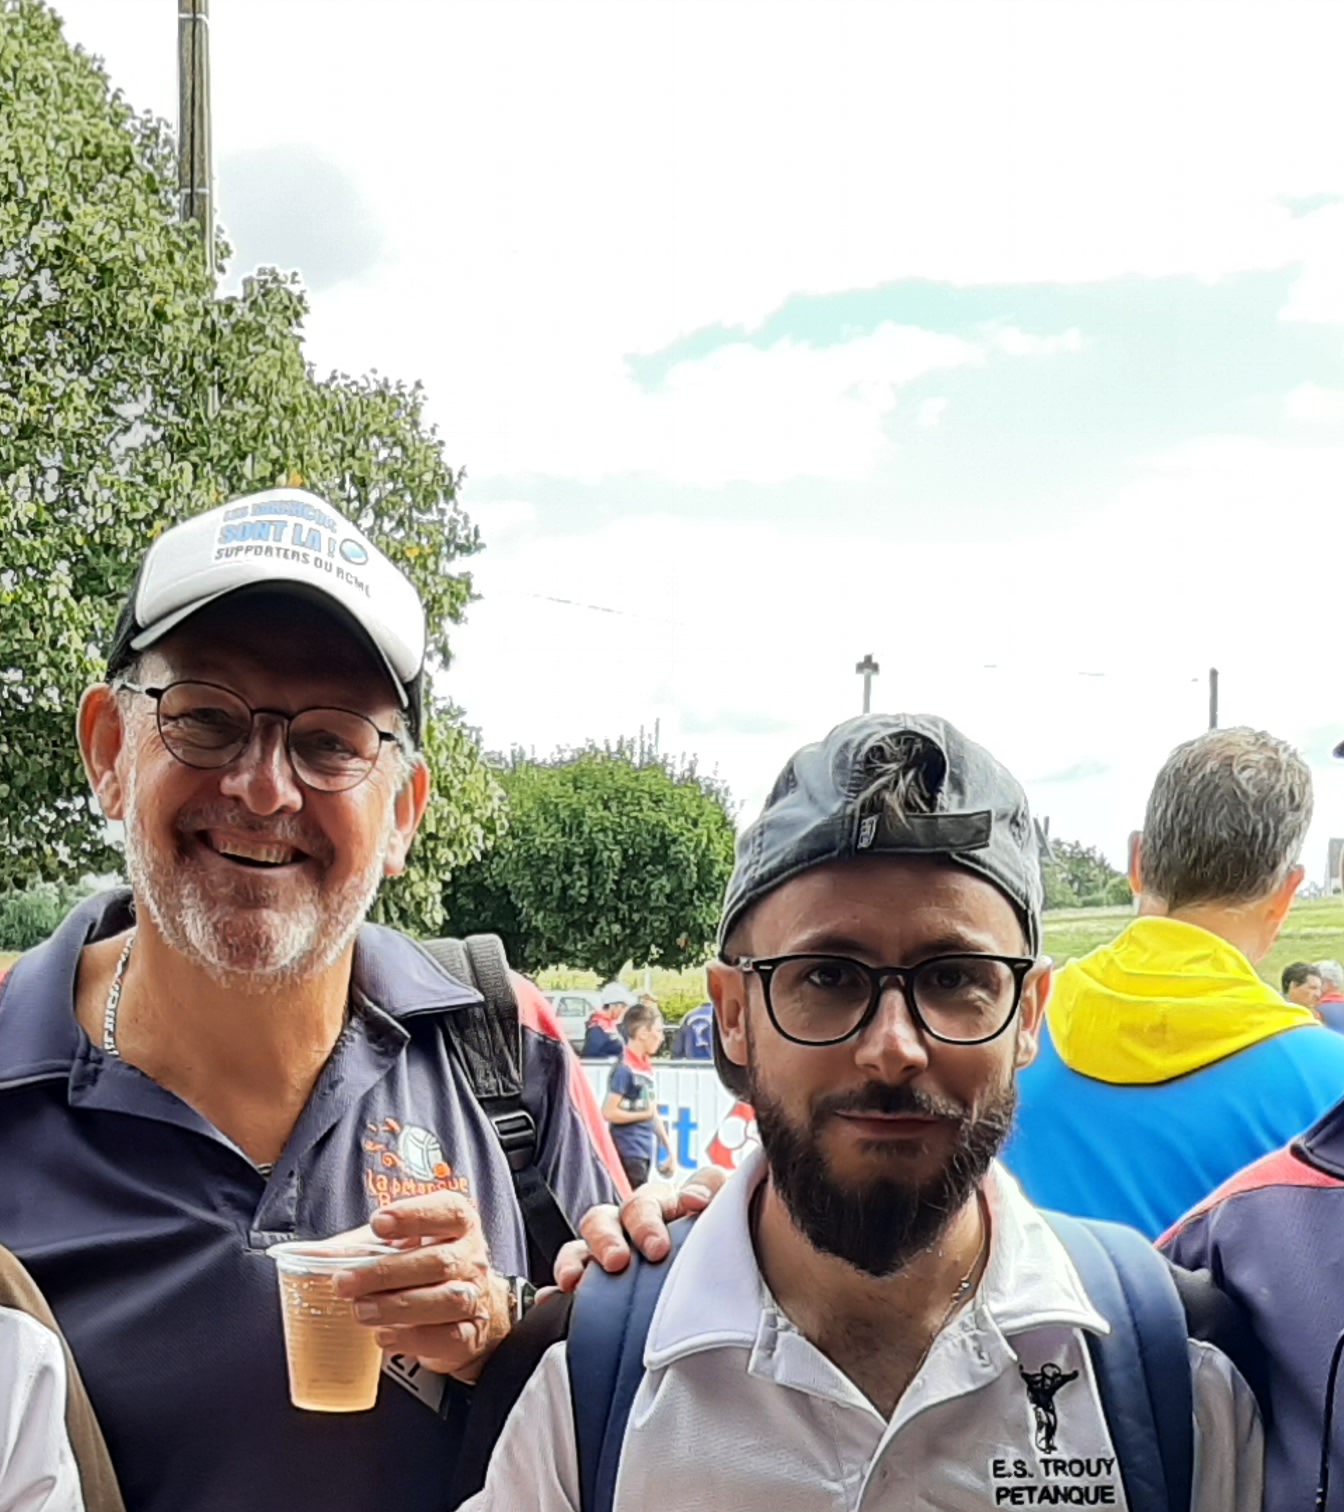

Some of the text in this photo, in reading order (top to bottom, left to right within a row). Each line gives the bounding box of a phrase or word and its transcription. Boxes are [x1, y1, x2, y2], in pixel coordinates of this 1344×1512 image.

[217, 519, 288, 545] SONT
[291, 522, 322, 553] LA
[214, 545, 310, 565] SUPPORTERS
[314, 556, 333, 573] DU
[992, 1457, 1116, 1479] E.S. TROUY
[995, 1485, 1116, 1506] PETANQUE
